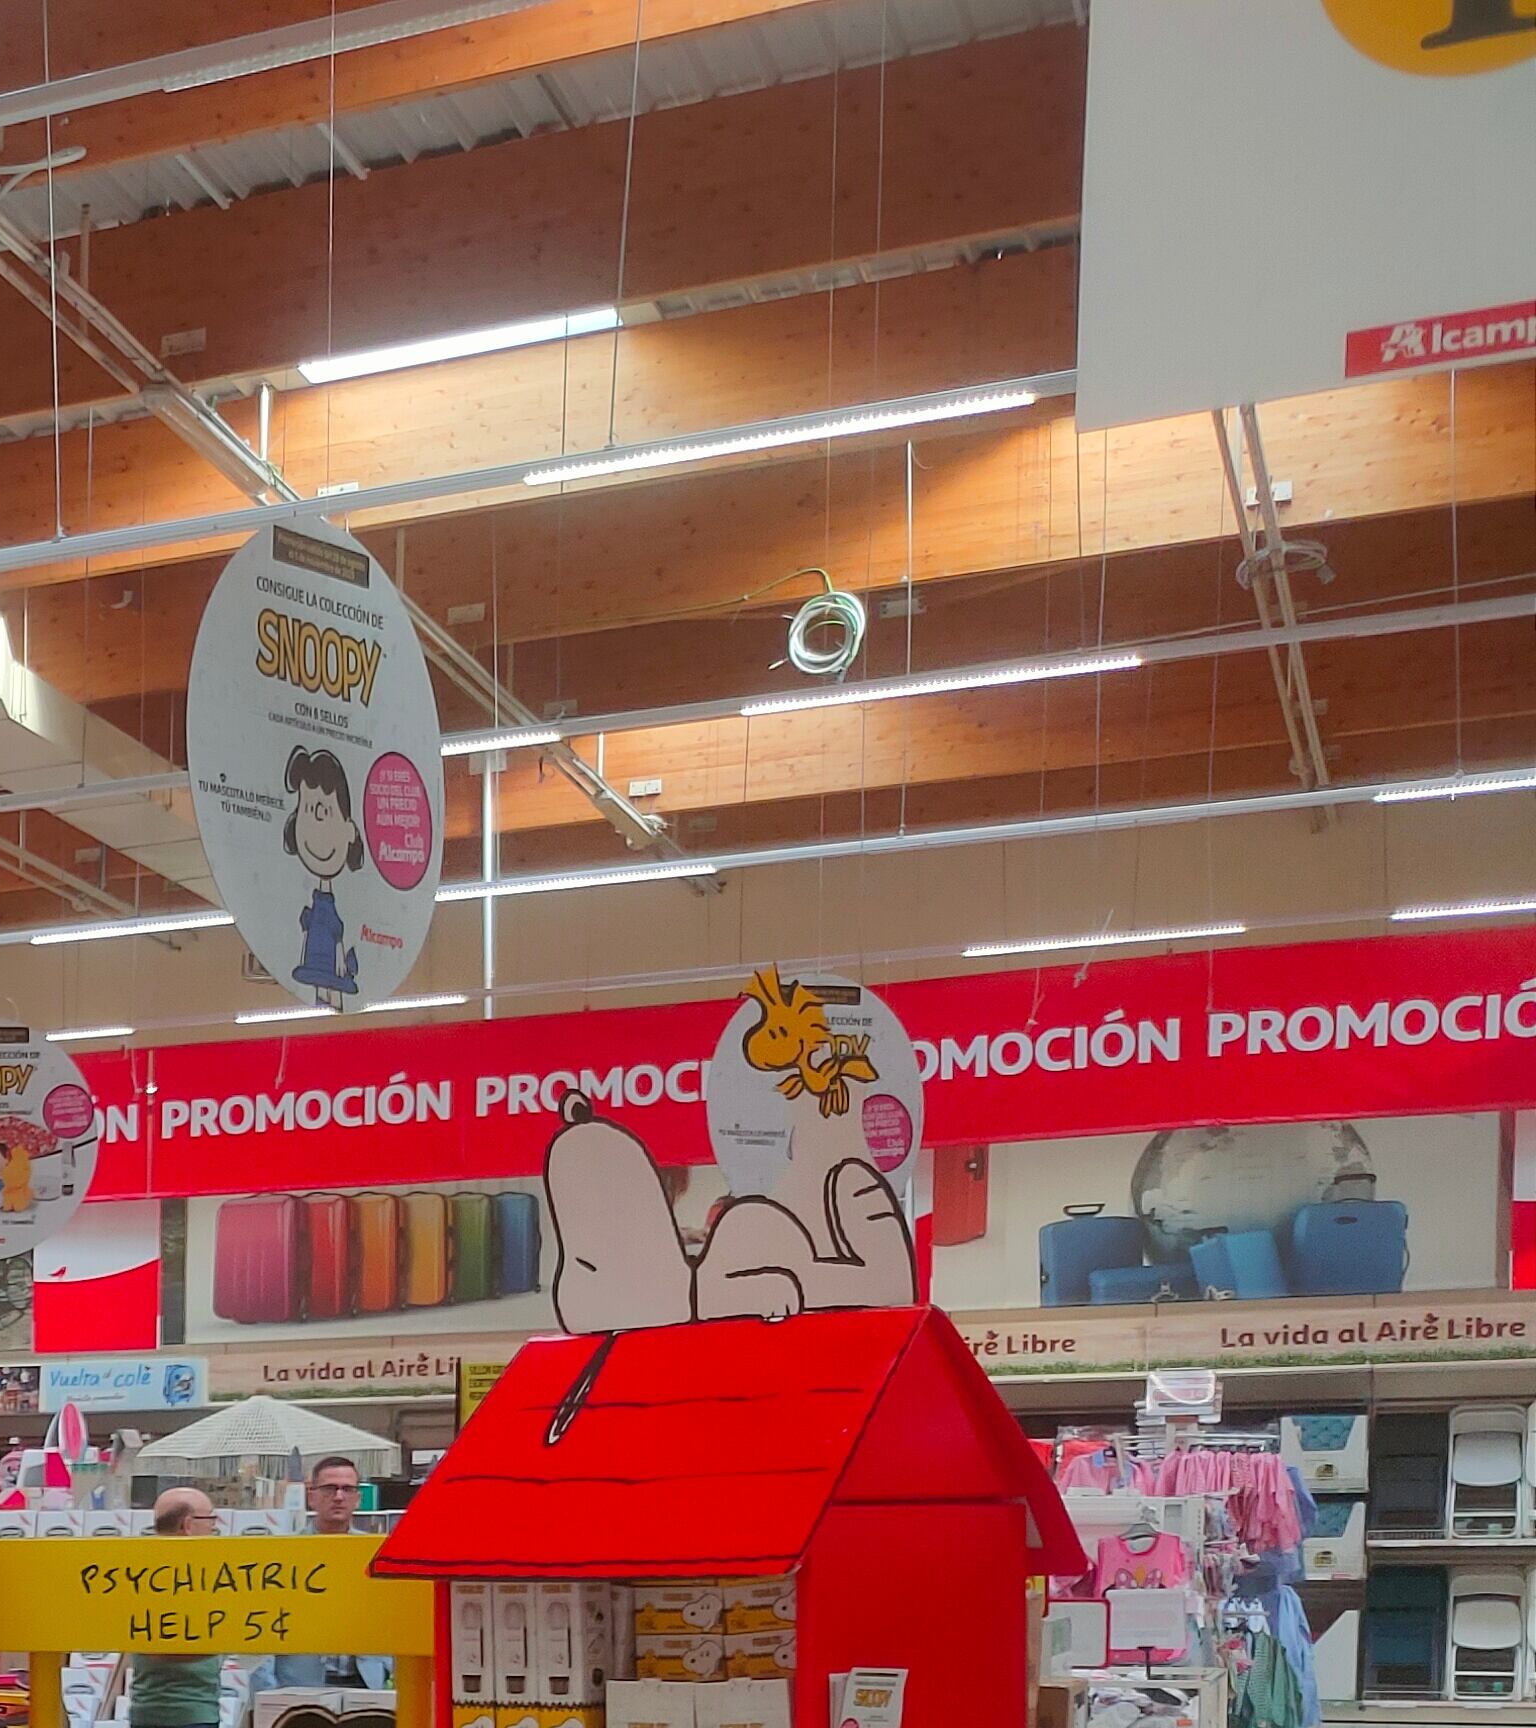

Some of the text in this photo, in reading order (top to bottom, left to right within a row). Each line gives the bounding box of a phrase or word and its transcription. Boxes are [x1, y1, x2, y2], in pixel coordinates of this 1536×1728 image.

[256, 607, 382, 708] SNOOPY
[161, 1071, 450, 1139] PROMOCIÓN
[1007, 1333, 1077, 1356] Libre
[1221, 1313, 1527, 1349] La vida al Libre
[264, 1364, 291, 1383] La
[296, 1361, 346, 1381] vida
[352, 1360, 374, 1379] al
[81, 1562, 327, 1595] PSYCHIATRIC
[130, 1608, 226, 1642] HELP
